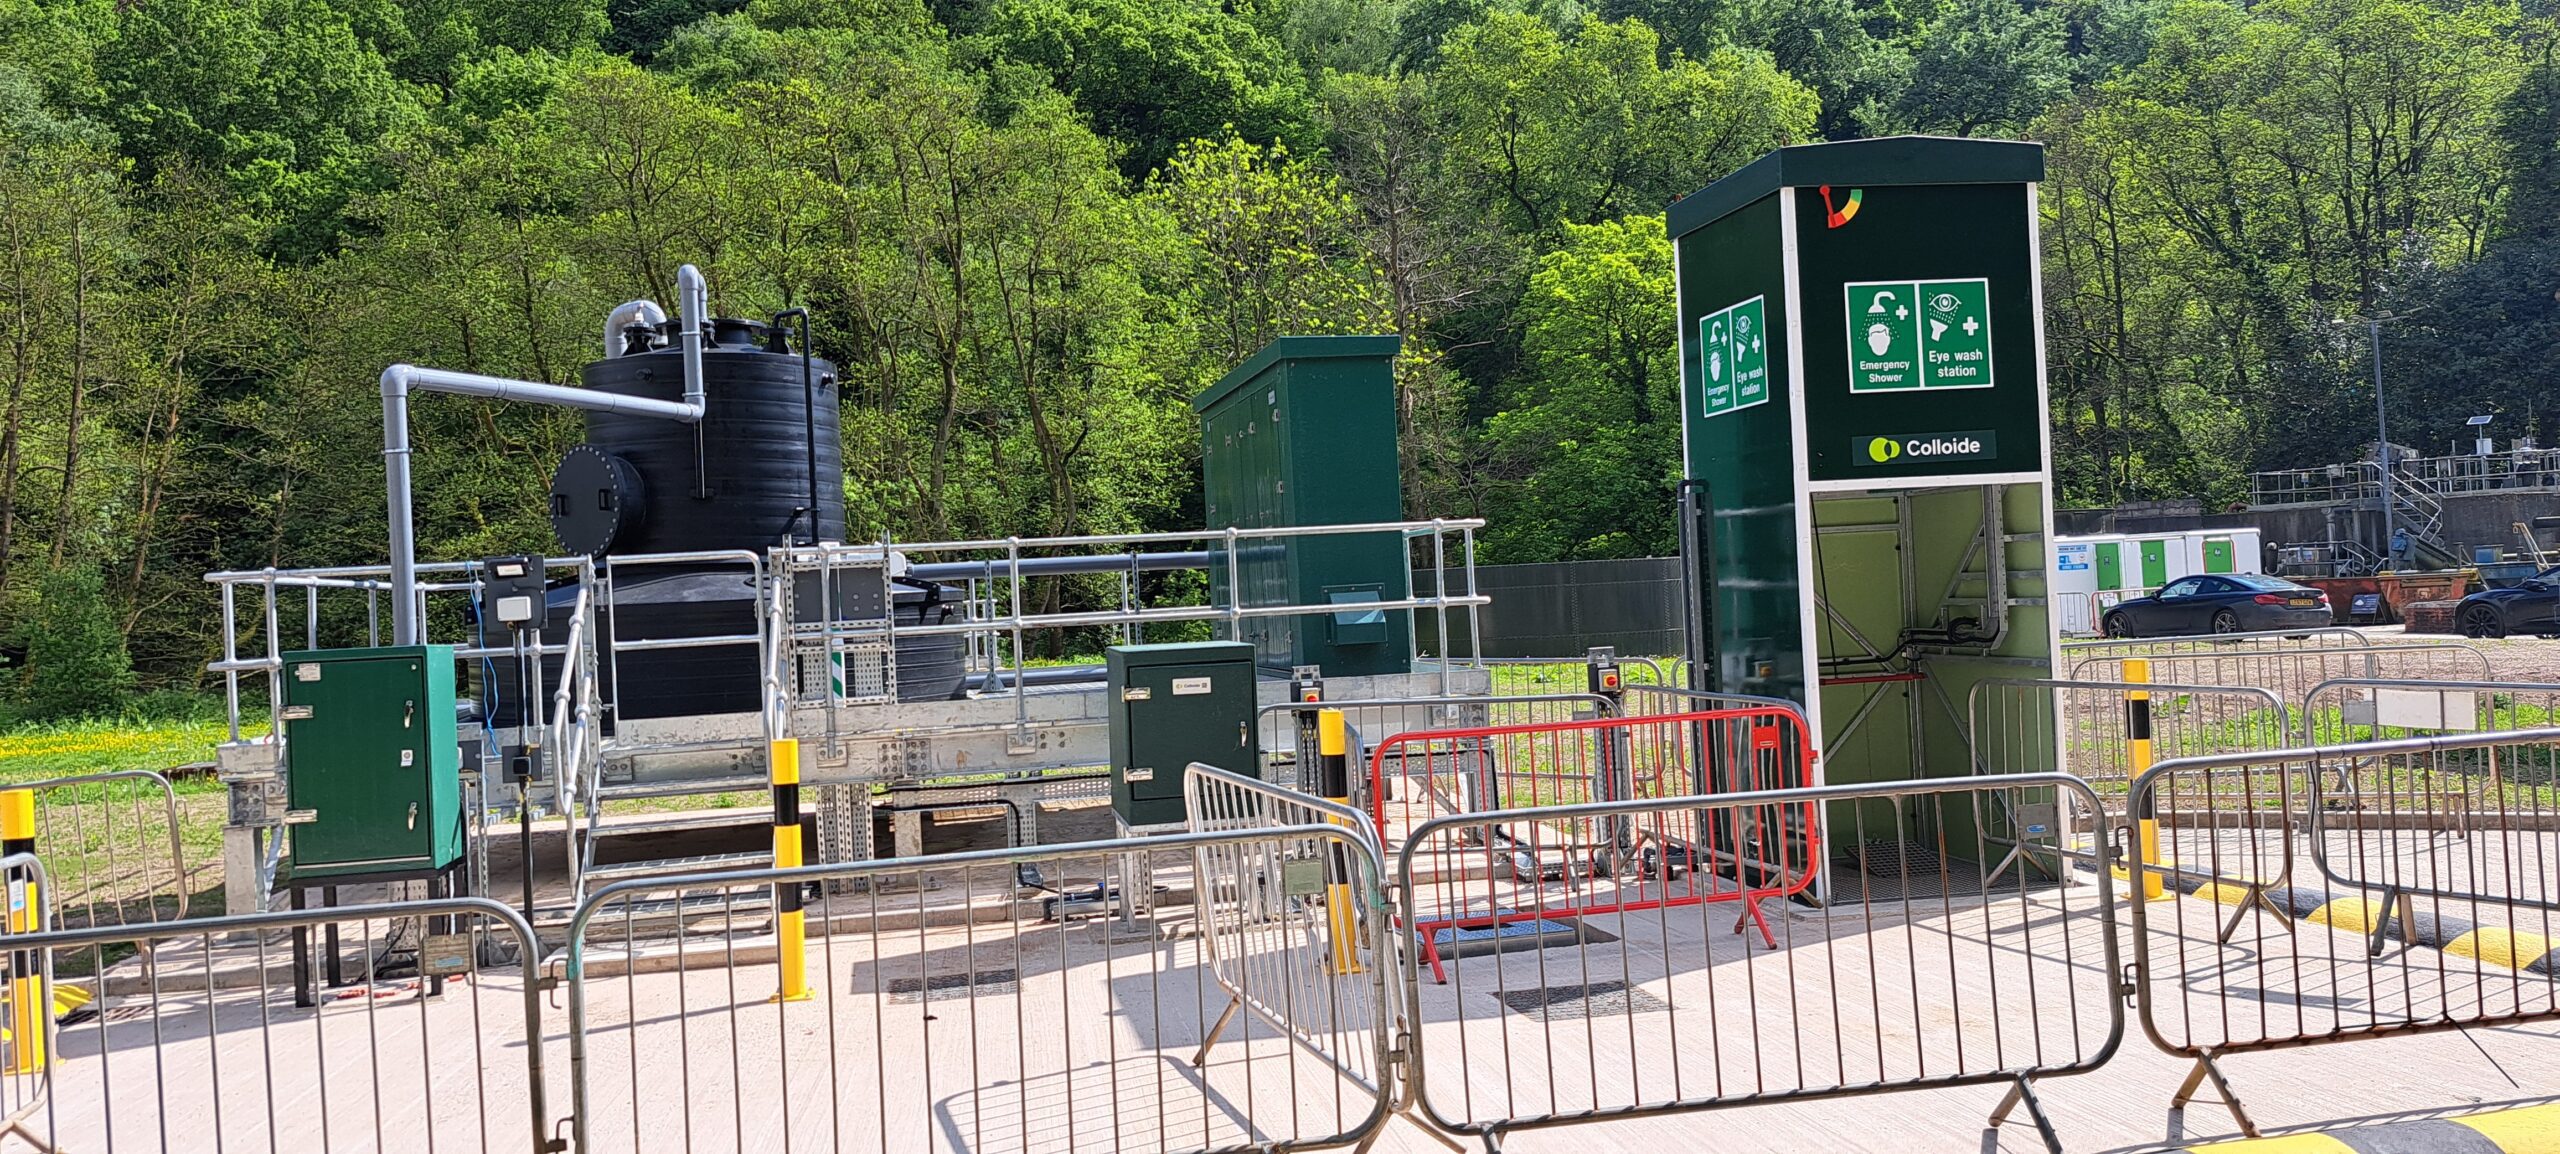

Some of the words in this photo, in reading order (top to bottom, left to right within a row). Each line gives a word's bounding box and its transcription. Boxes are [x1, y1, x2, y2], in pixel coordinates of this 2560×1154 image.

[1928, 350, 1950, 364] Eye
[1954, 348, 1983, 361] wash
[1859, 360, 1910, 372] Emergency
[1937, 365, 1977, 378] station
[1737, 371, 1747, 384] Eye
[1749, 366, 1763, 379] wash
[1868, 373, 1903, 383] Shower
[1741, 383, 1760, 396] station
[1906, 437, 1981, 456] Colloide
